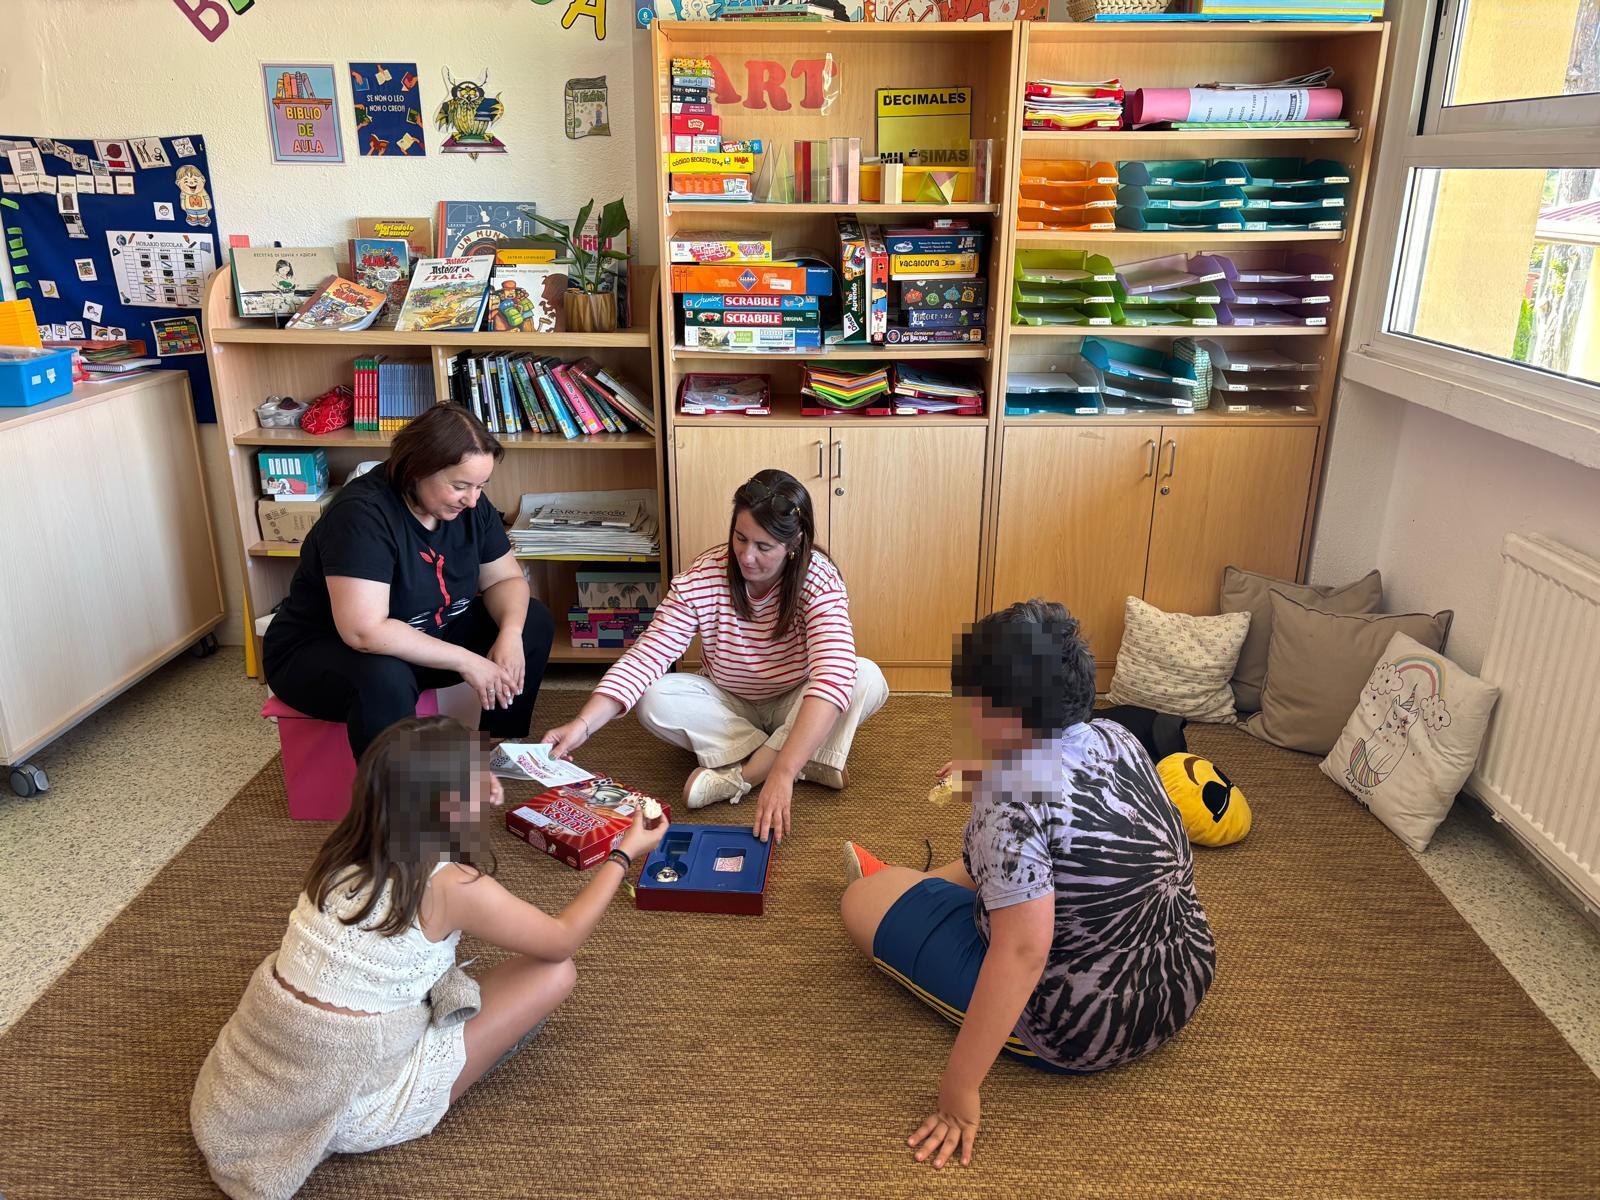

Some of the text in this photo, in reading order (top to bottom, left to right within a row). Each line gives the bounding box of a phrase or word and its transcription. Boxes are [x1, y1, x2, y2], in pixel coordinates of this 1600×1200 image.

[367, 94, 375, 102] SE
[375, 94, 387, 102] NON
[394, 94, 404, 102] LEO
[883, 93, 967, 106] DECIMALES
[285, 106, 322, 121] BIBLIO
[297, 122, 314, 137] DE
[293, 139, 325, 154] AULA
[733, 156, 750, 165] HABA
[188, 195, 203, 208] M
[136, 240, 160, 248] HORARIO
[458, 235, 472, 252] UN
[725, 296, 780, 307] SCRABBLE
[725, 312, 781, 324] SCRABBLE
[845, 313, 858, 332] Diset
